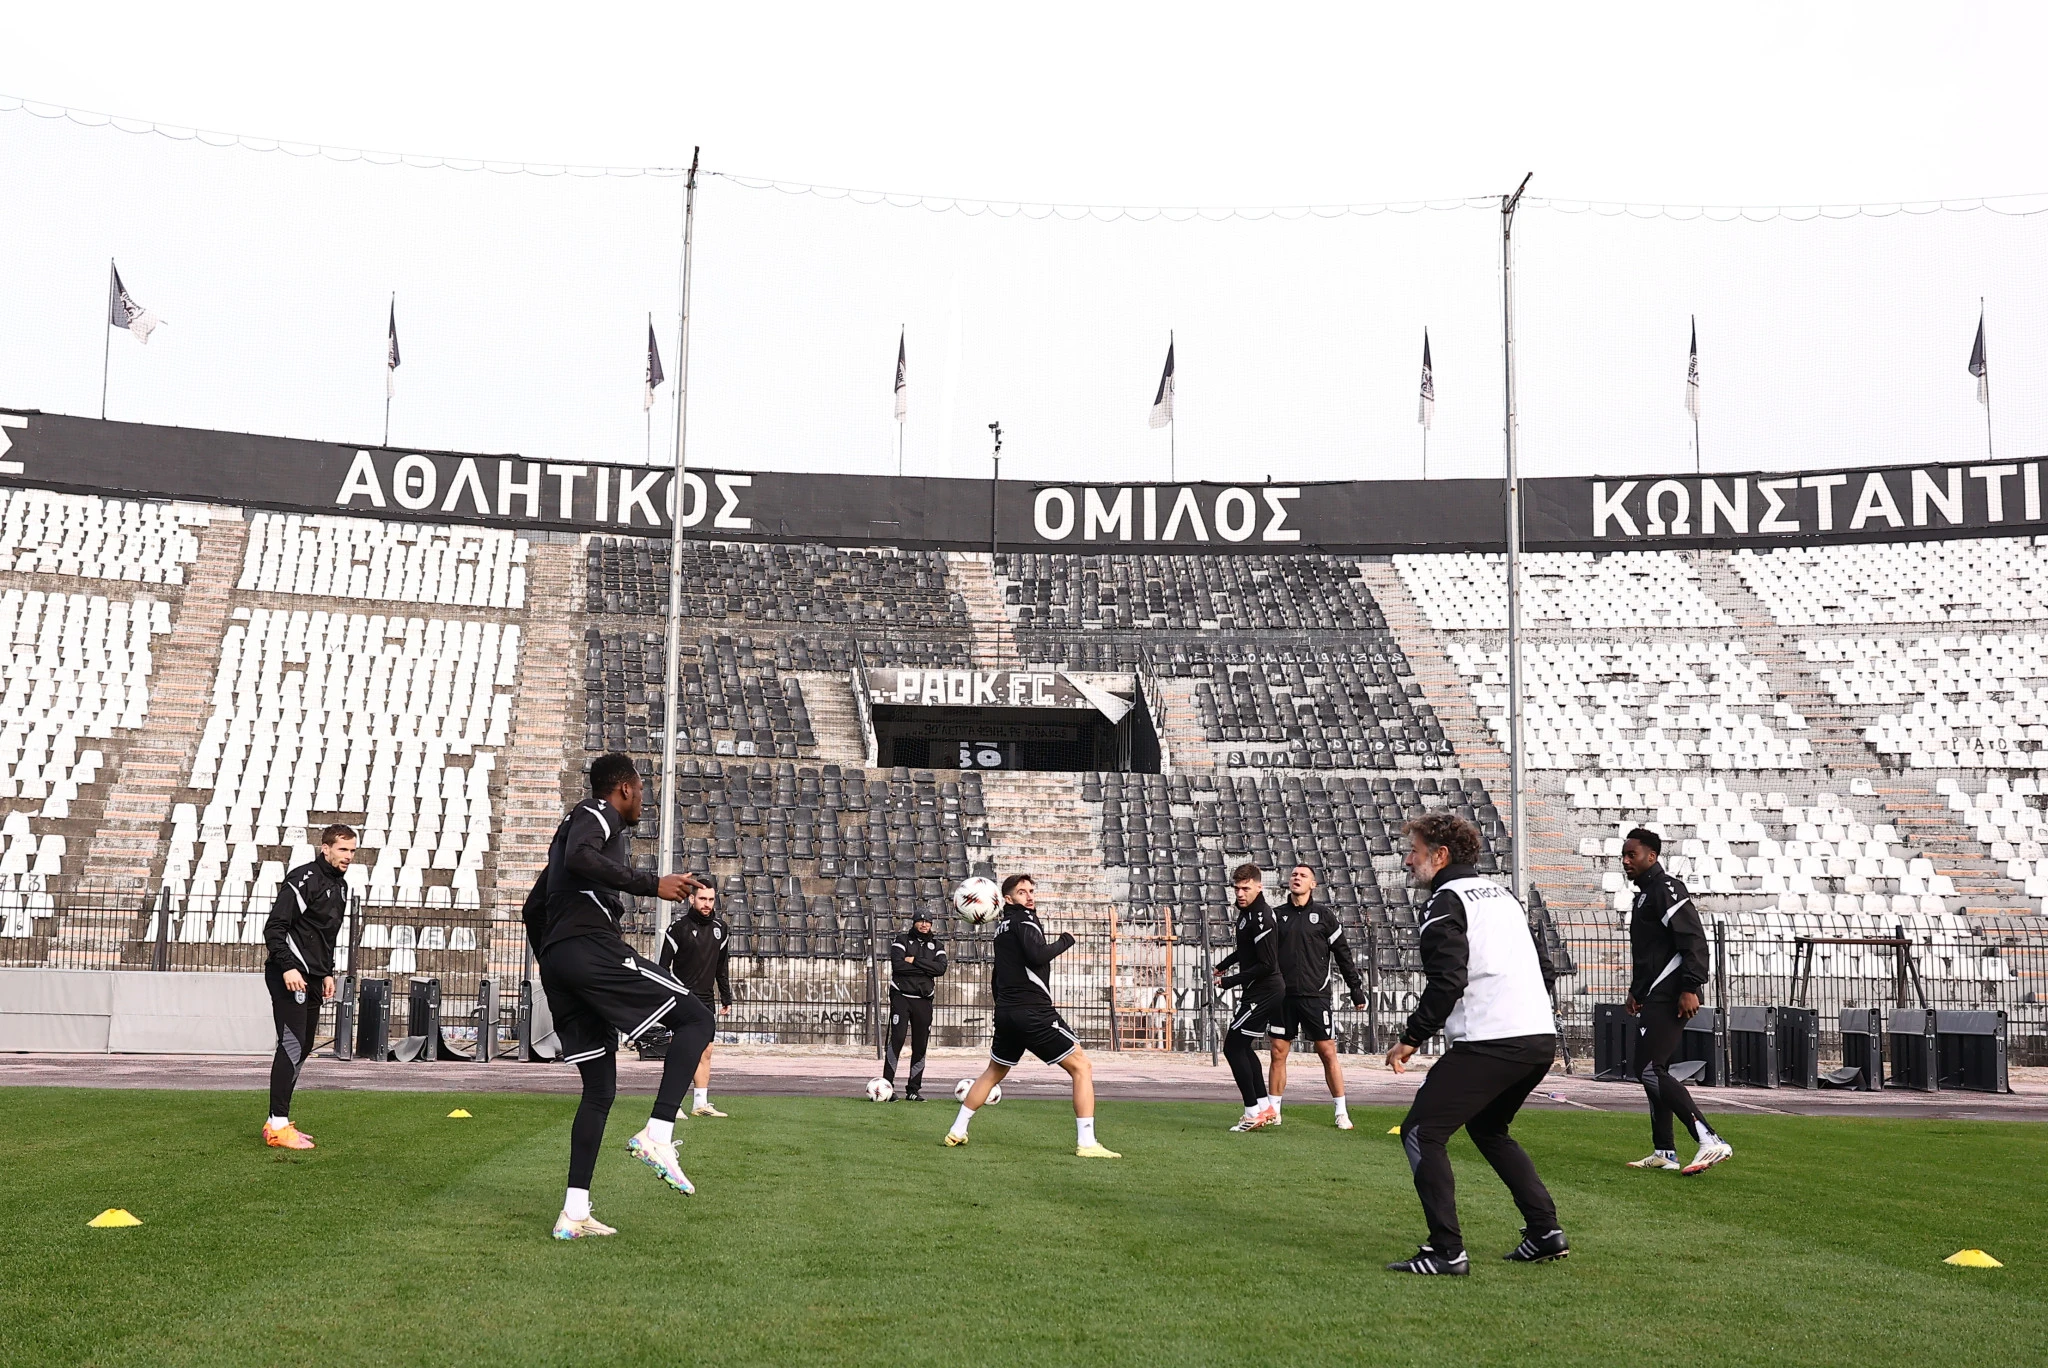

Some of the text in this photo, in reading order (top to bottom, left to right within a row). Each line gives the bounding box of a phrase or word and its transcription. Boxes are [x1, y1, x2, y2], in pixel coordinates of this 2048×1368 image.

[335, 449, 752, 529] ΑΘΛΗΤΙΚΟΣ
[1034, 486, 1301, 542] ΟΜΙΛΟΣ
[1592, 462, 2041, 537] ΚΩΝΣΤΑΝΤΙ
[897, 671, 1055, 706] PAOK FC
